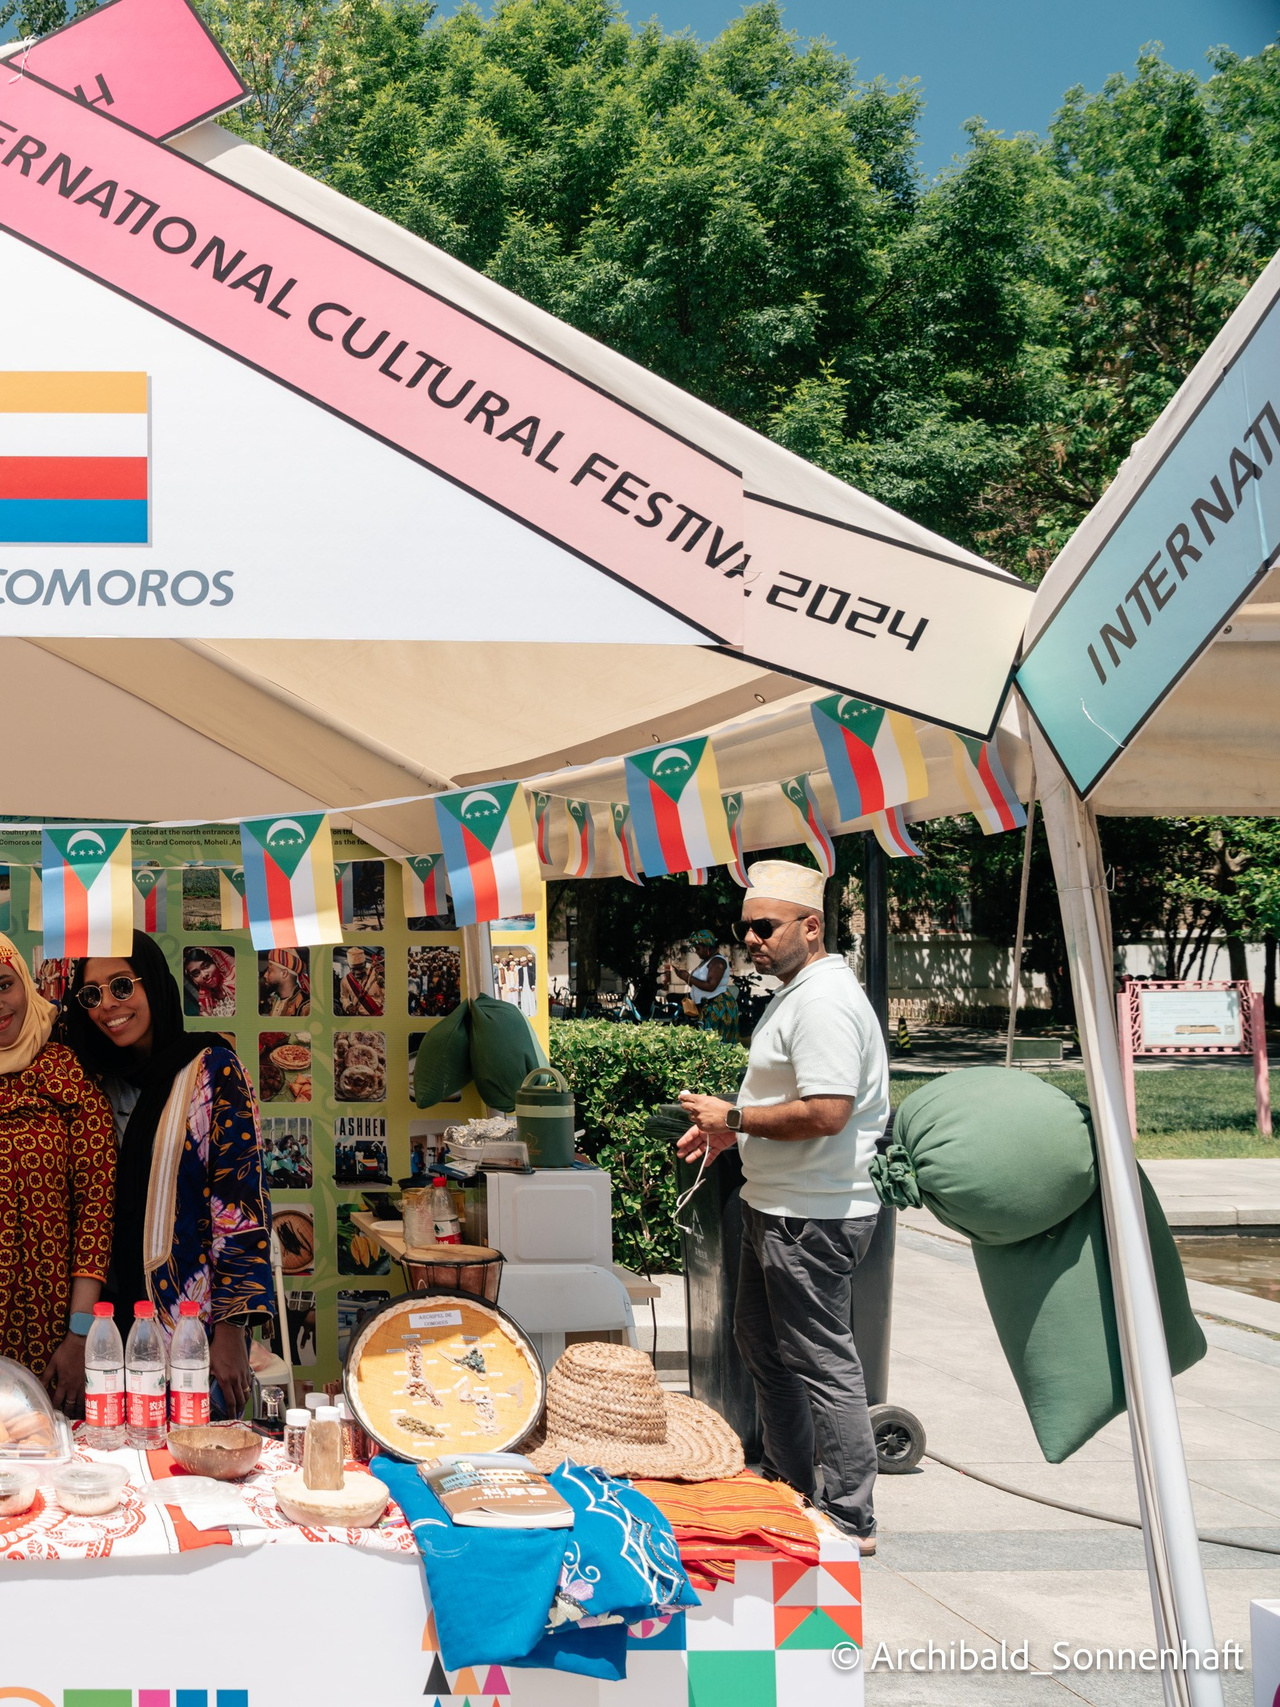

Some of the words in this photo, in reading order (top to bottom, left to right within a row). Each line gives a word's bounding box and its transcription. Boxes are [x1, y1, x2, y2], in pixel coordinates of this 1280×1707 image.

[308, 302, 566, 473] CULTURAL
[766, 570, 929, 651] 2024
[334, 1117, 386, 1137] ASHKEN
